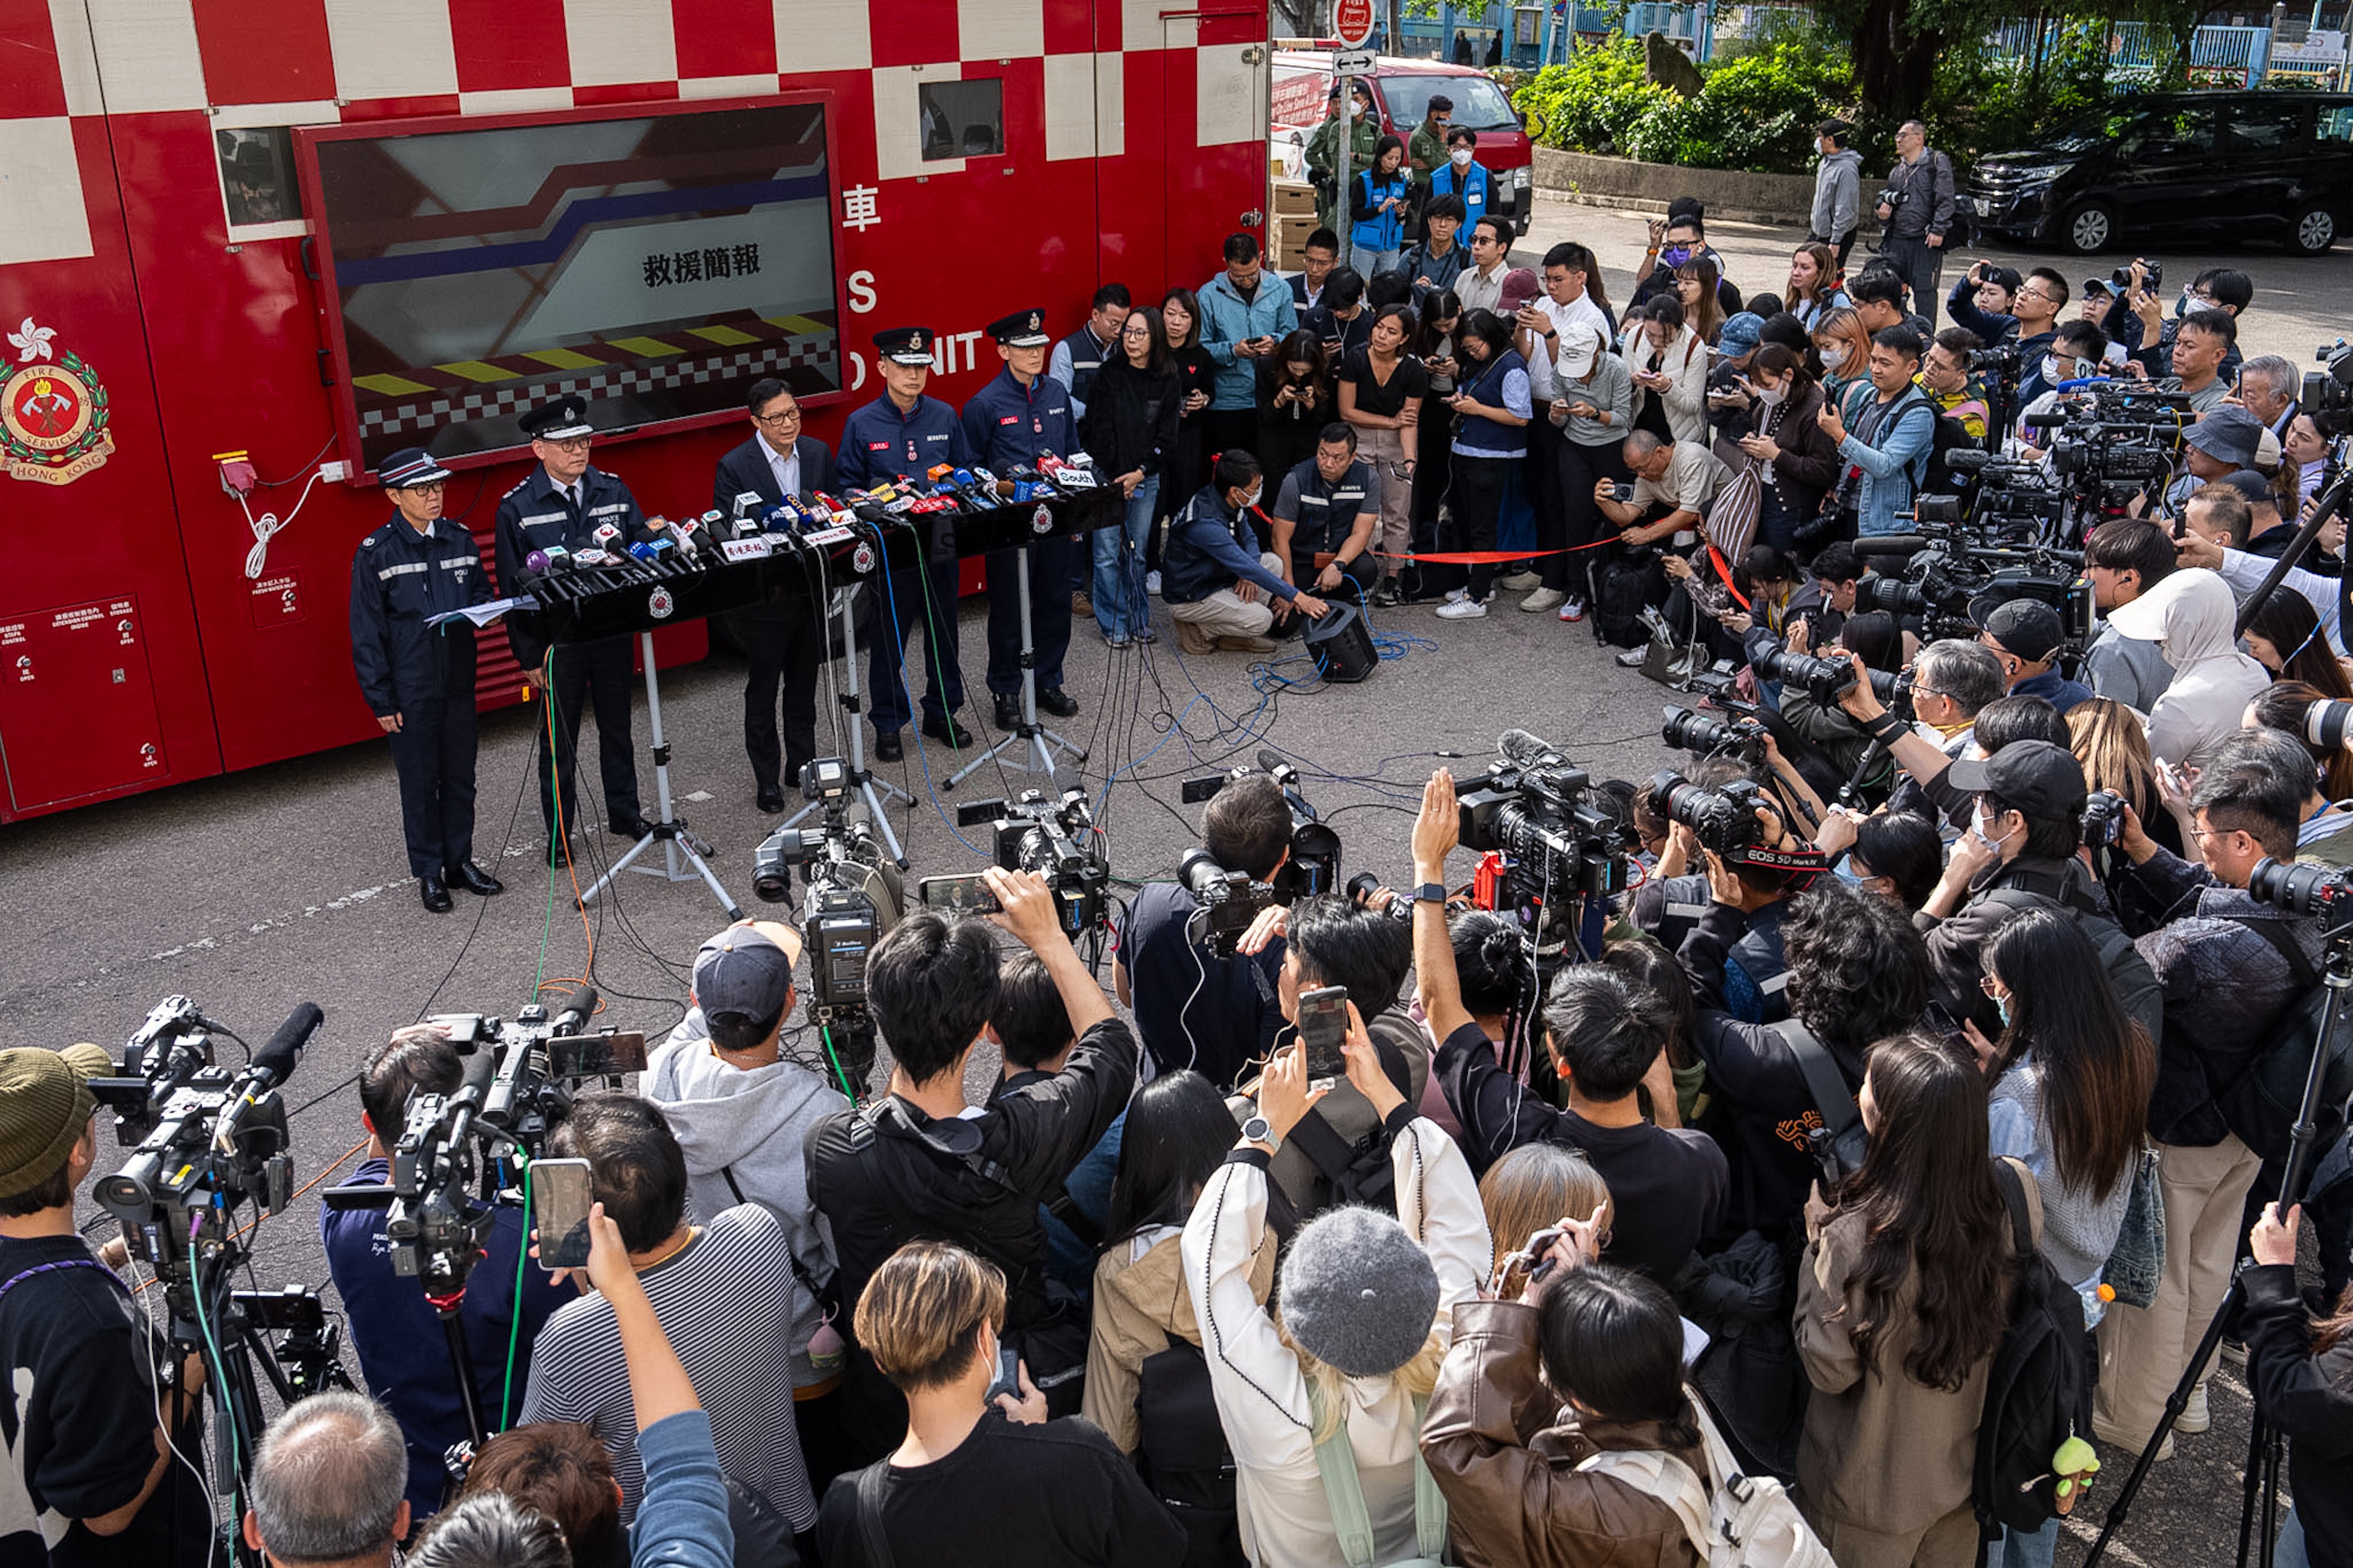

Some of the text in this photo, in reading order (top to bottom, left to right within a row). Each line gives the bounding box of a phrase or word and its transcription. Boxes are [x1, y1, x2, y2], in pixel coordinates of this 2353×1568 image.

[843, 184, 882, 232] 車
[643, 243, 761, 287] 救援簡報
[849, 270, 877, 313] S
[24, 367, 55, 380] FIRE
[25, 430, 80, 449] SERVICES
[16, 454, 102, 482] HONG KONG
[1060, 472, 1093, 484] South
[786, 495, 810, 515] CGTN
[1747, 850, 1775, 863] EOS
[1777, 854, 1792, 865] 5D
